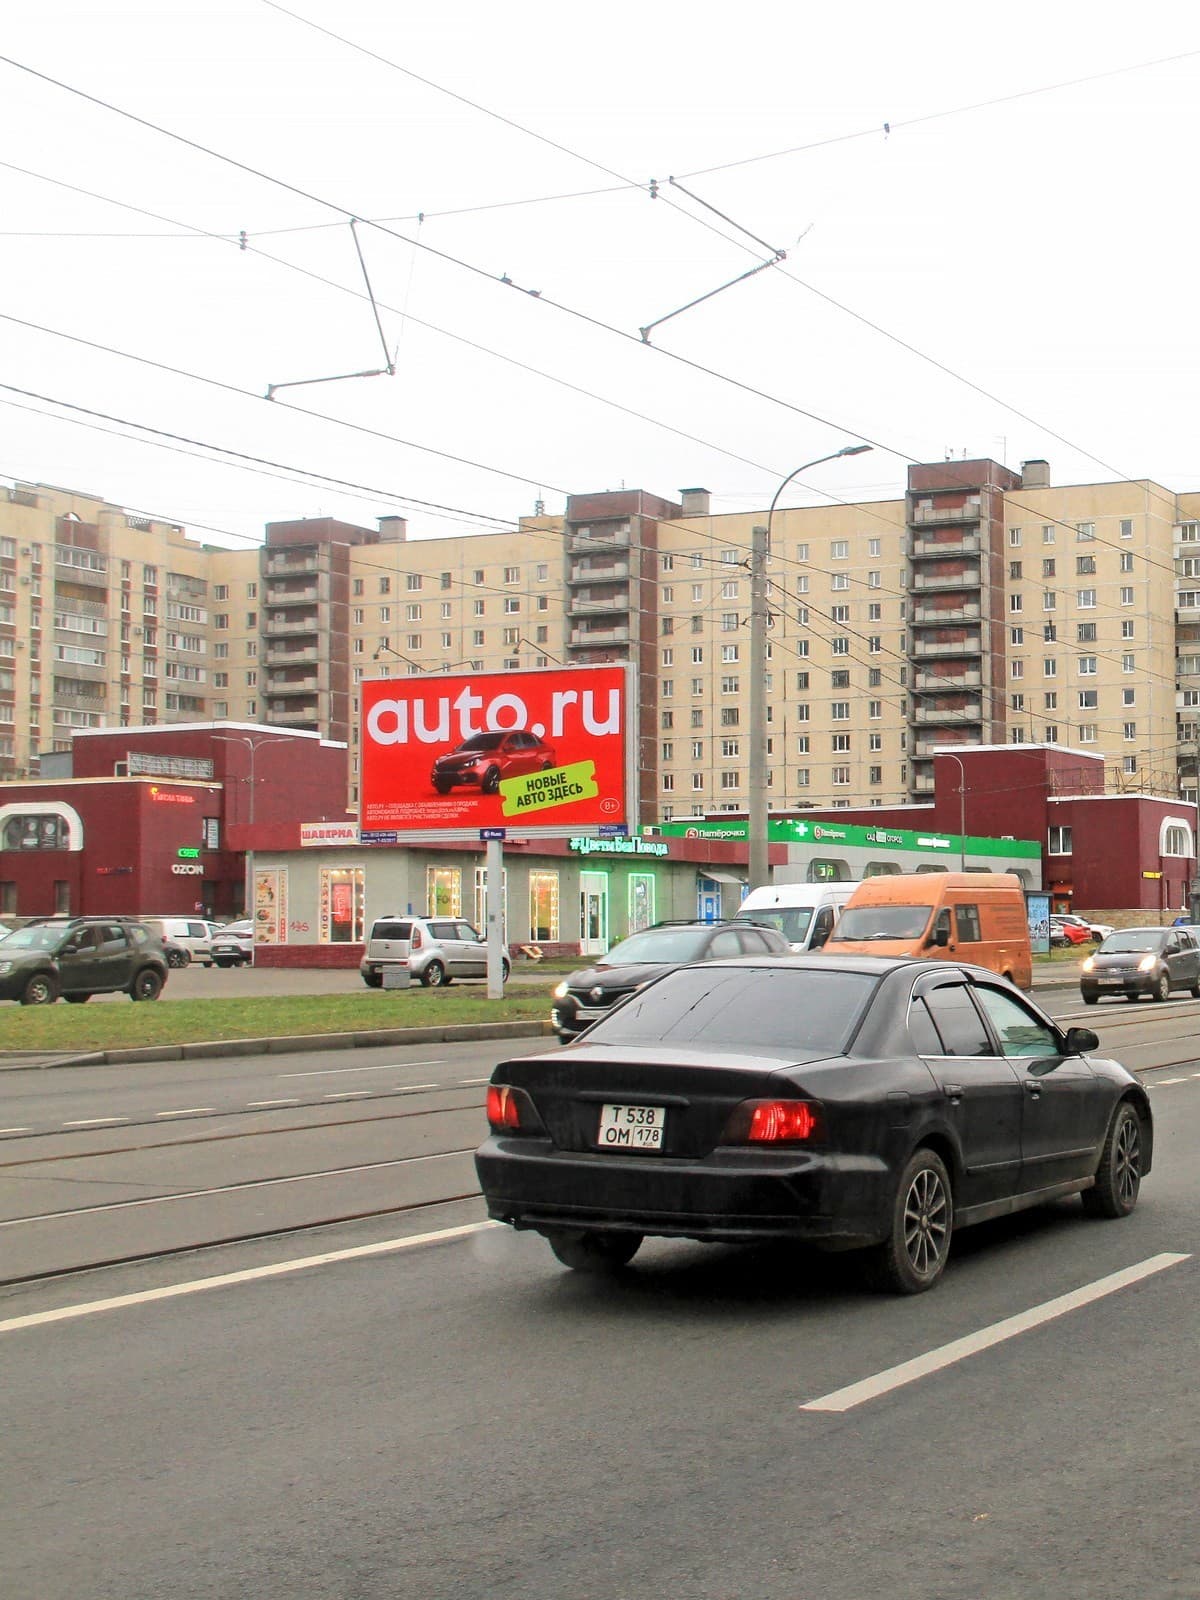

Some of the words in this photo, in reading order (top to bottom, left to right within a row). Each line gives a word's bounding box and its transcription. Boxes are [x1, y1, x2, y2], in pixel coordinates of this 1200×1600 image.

[366, 685, 620, 745] auto.ru
[526, 772, 567, 791] НОВЫЕ
[517, 791, 546, 808] АВТО
[547, 783, 584, 801] ЗДЕСЬ
[171, 864, 204, 875] OZON
[637, 1129, 659, 1142] 178
